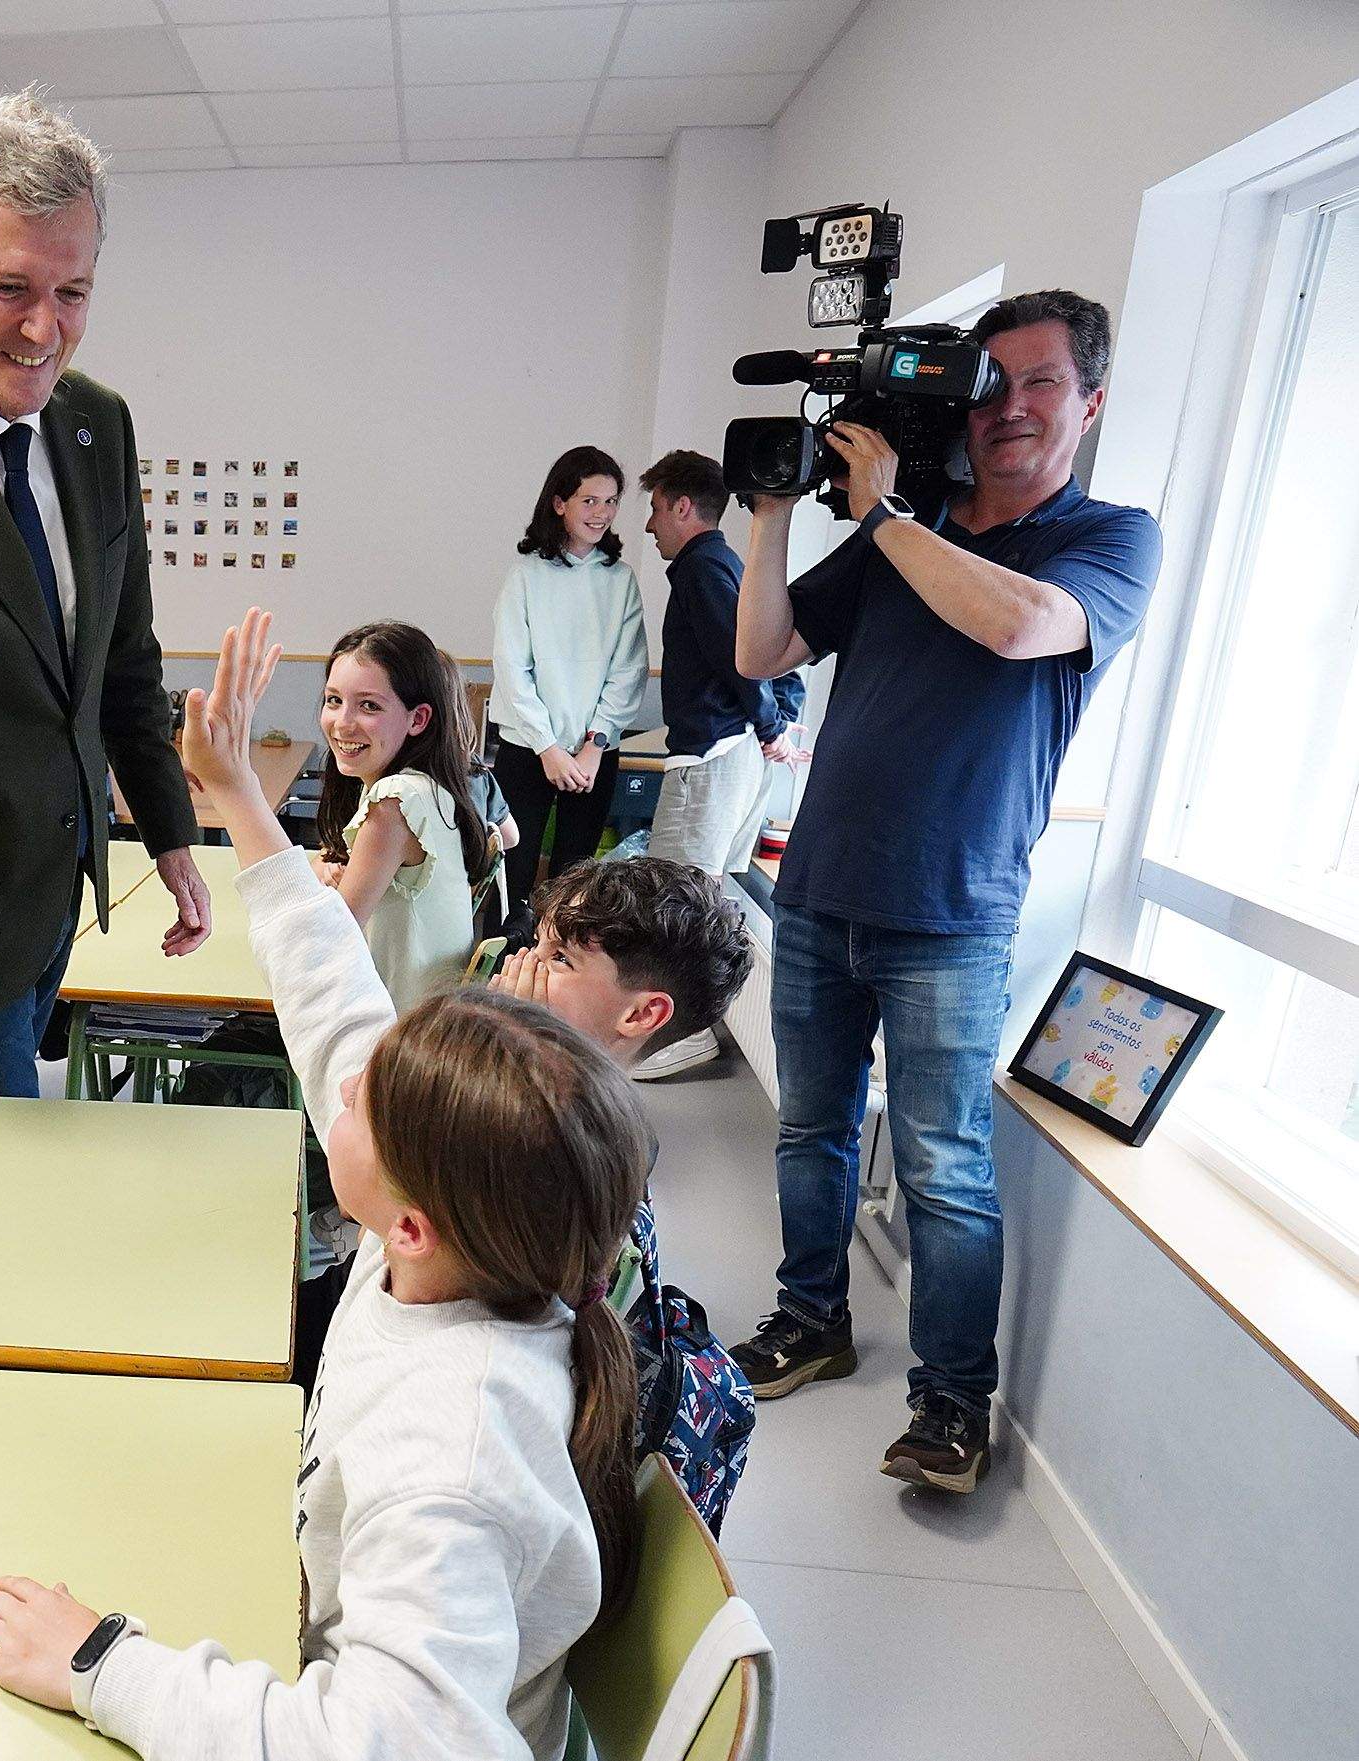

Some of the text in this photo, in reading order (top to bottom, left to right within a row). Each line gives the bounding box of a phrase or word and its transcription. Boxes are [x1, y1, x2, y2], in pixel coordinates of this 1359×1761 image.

[1103, 1006, 1143, 1032] Todos os
[1087, 1019, 1142, 1050] sentimentos
[1097, 1041, 1114, 1054] son
[1083, 1049, 1114, 1072] válidos
